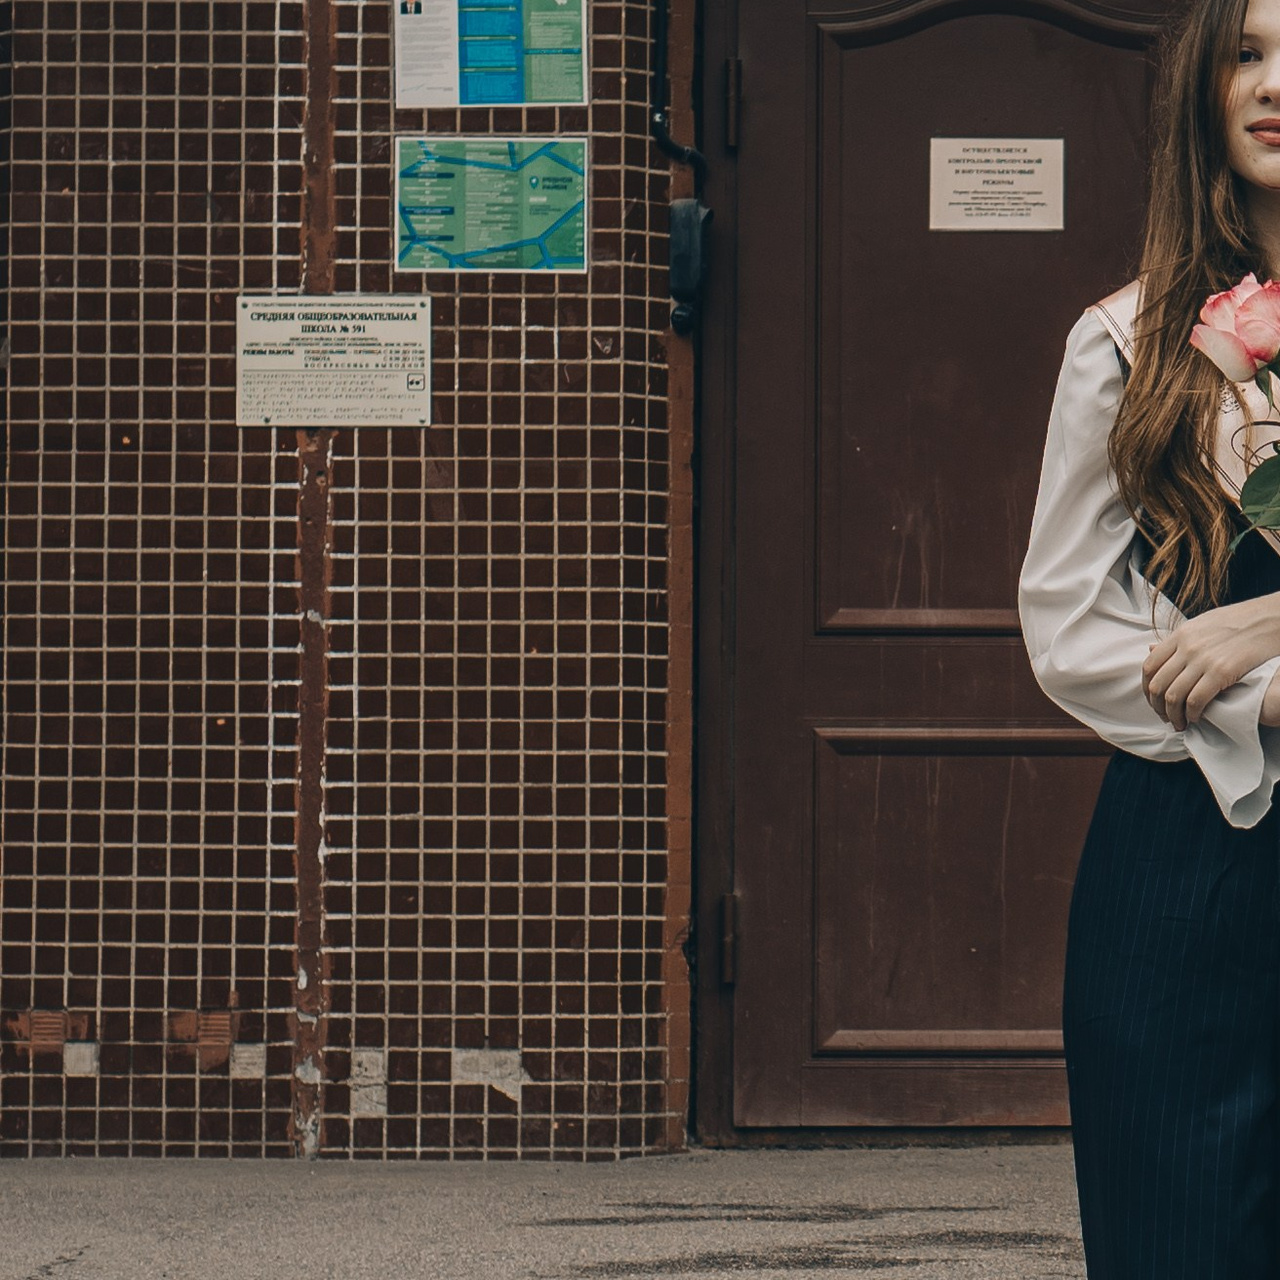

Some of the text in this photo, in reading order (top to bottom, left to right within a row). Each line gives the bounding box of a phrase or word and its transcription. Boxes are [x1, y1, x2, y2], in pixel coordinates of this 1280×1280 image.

[250, 312, 417, 322] СРЕДНЯЯ ОБЩЕОБРАЗОВАТЕЛЬНАЯ
[301, 325, 336, 333] ШКОЛА
[352, 325, 366, 333] 591
